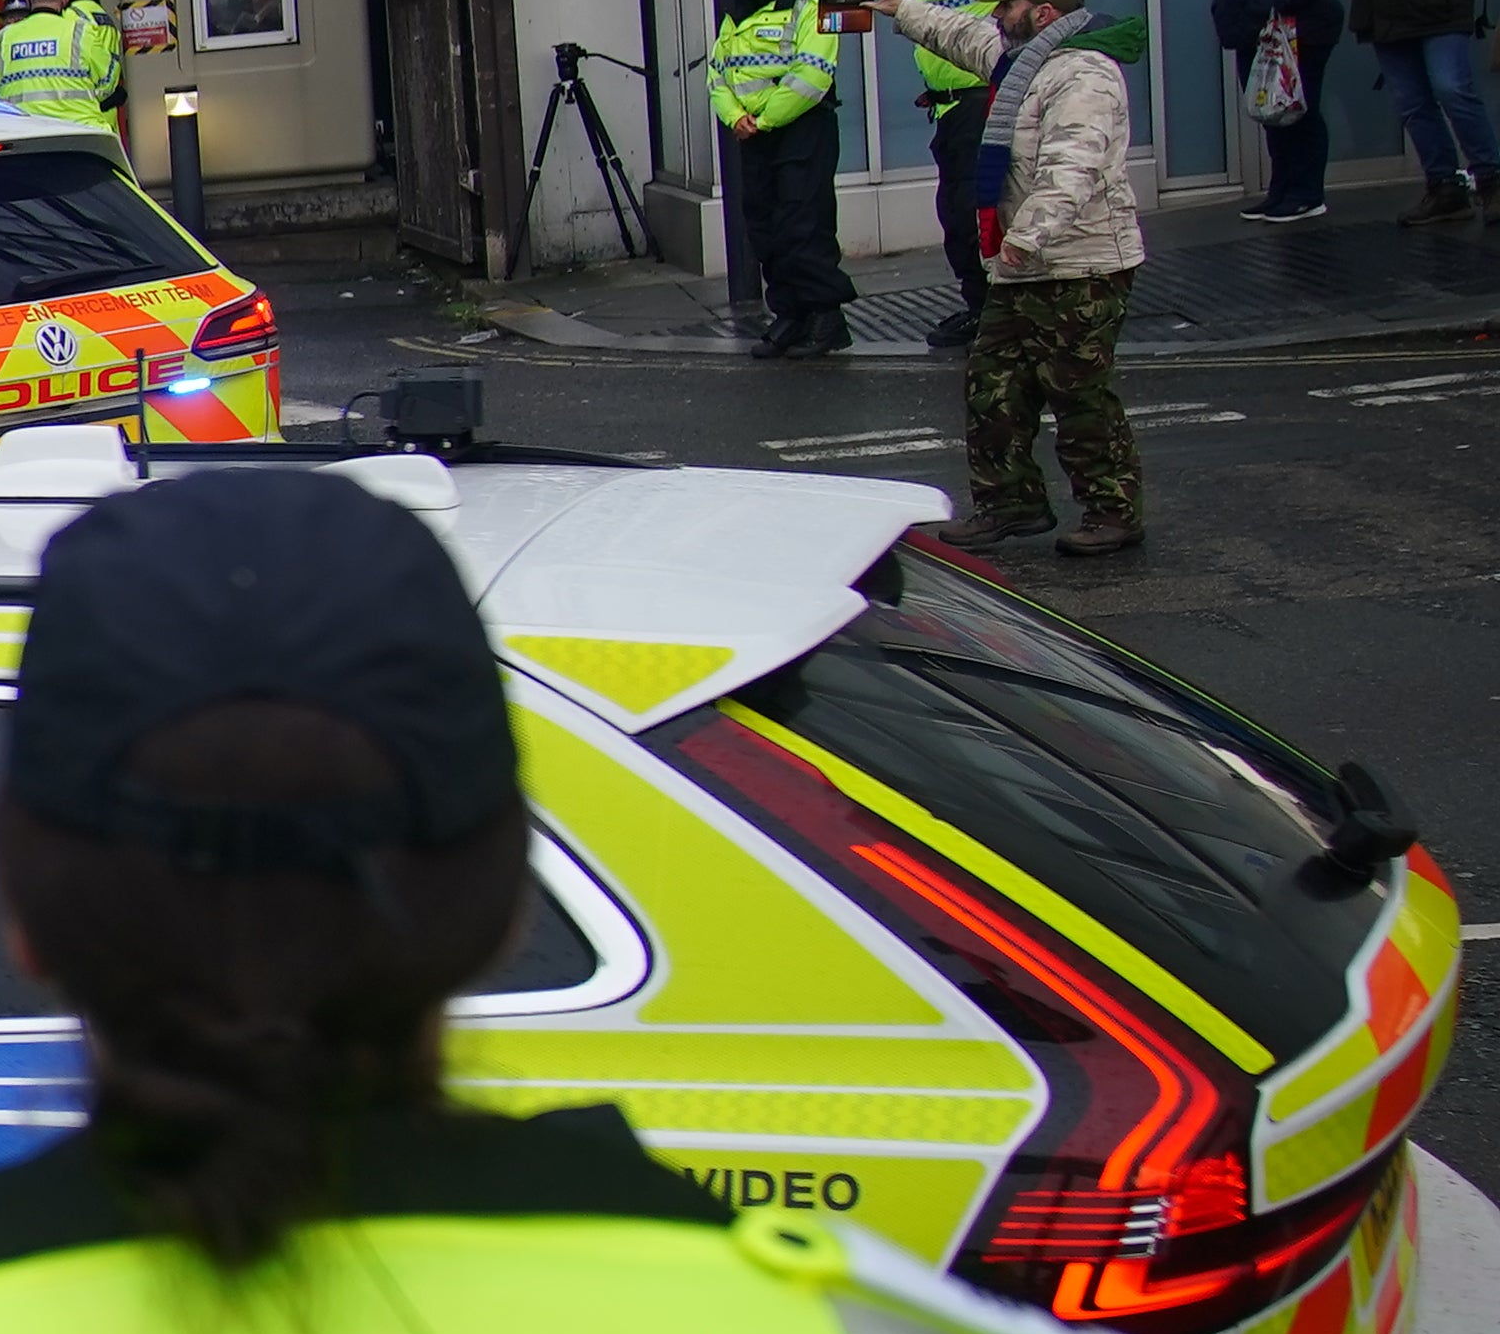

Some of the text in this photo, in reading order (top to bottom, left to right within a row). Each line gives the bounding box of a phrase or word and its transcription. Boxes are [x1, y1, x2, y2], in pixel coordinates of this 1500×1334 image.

[13, 42, 55, 59] POLICE
[23, 294, 163, 324] ENFORCEMENT
[164, 284, 214, 303] TEAM
[683, 1167, 860, 1211] VIDEO
